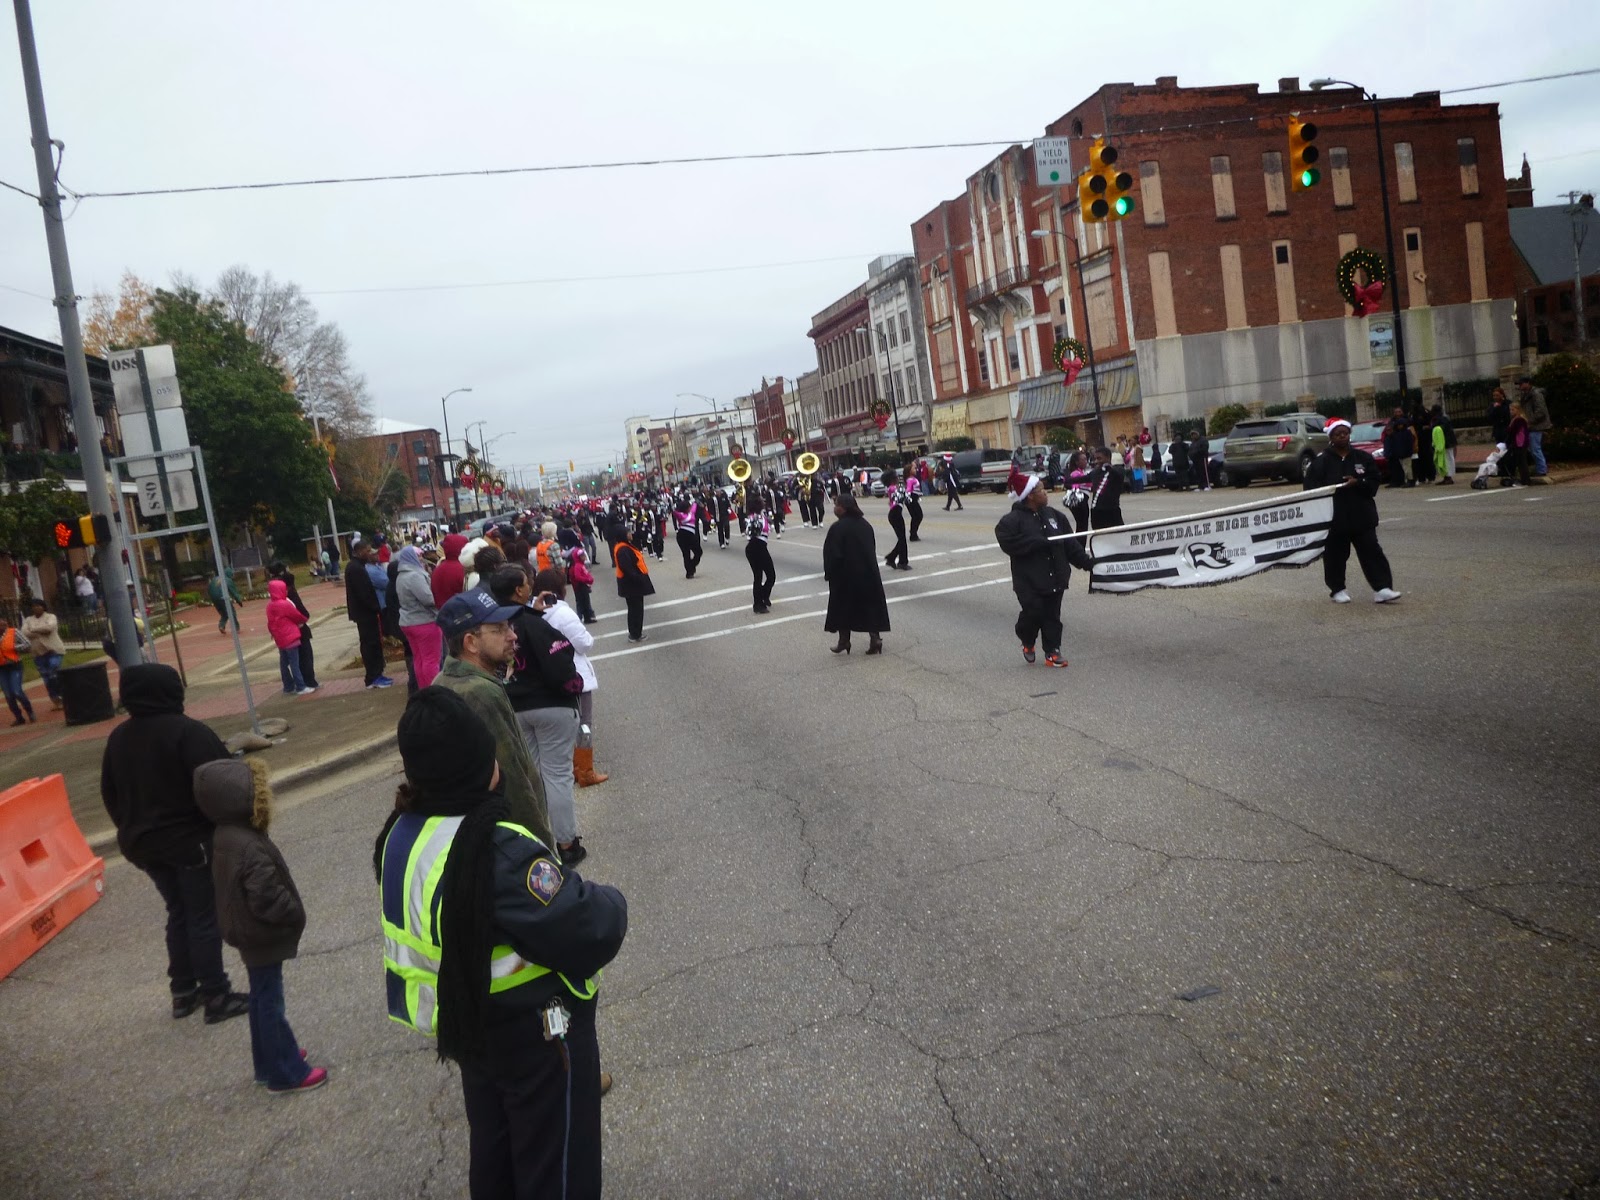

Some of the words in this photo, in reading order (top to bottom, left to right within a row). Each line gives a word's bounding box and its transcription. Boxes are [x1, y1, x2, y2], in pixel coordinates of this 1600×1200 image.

[1042, 149, 1062, 157] YIELD
[111, 357, 137, 372] OSS
[145, 482, 160, 510] OSS
[1130, 522, 1211, 546] RIVERDALE
[1216, 517, 1249, 533] HIGH
[1253, 506, 1304, 527] SCHOOL
[1105, 559, 1160, 574] MARCHING
[1276, 536, 1307, 550] PRIDE
